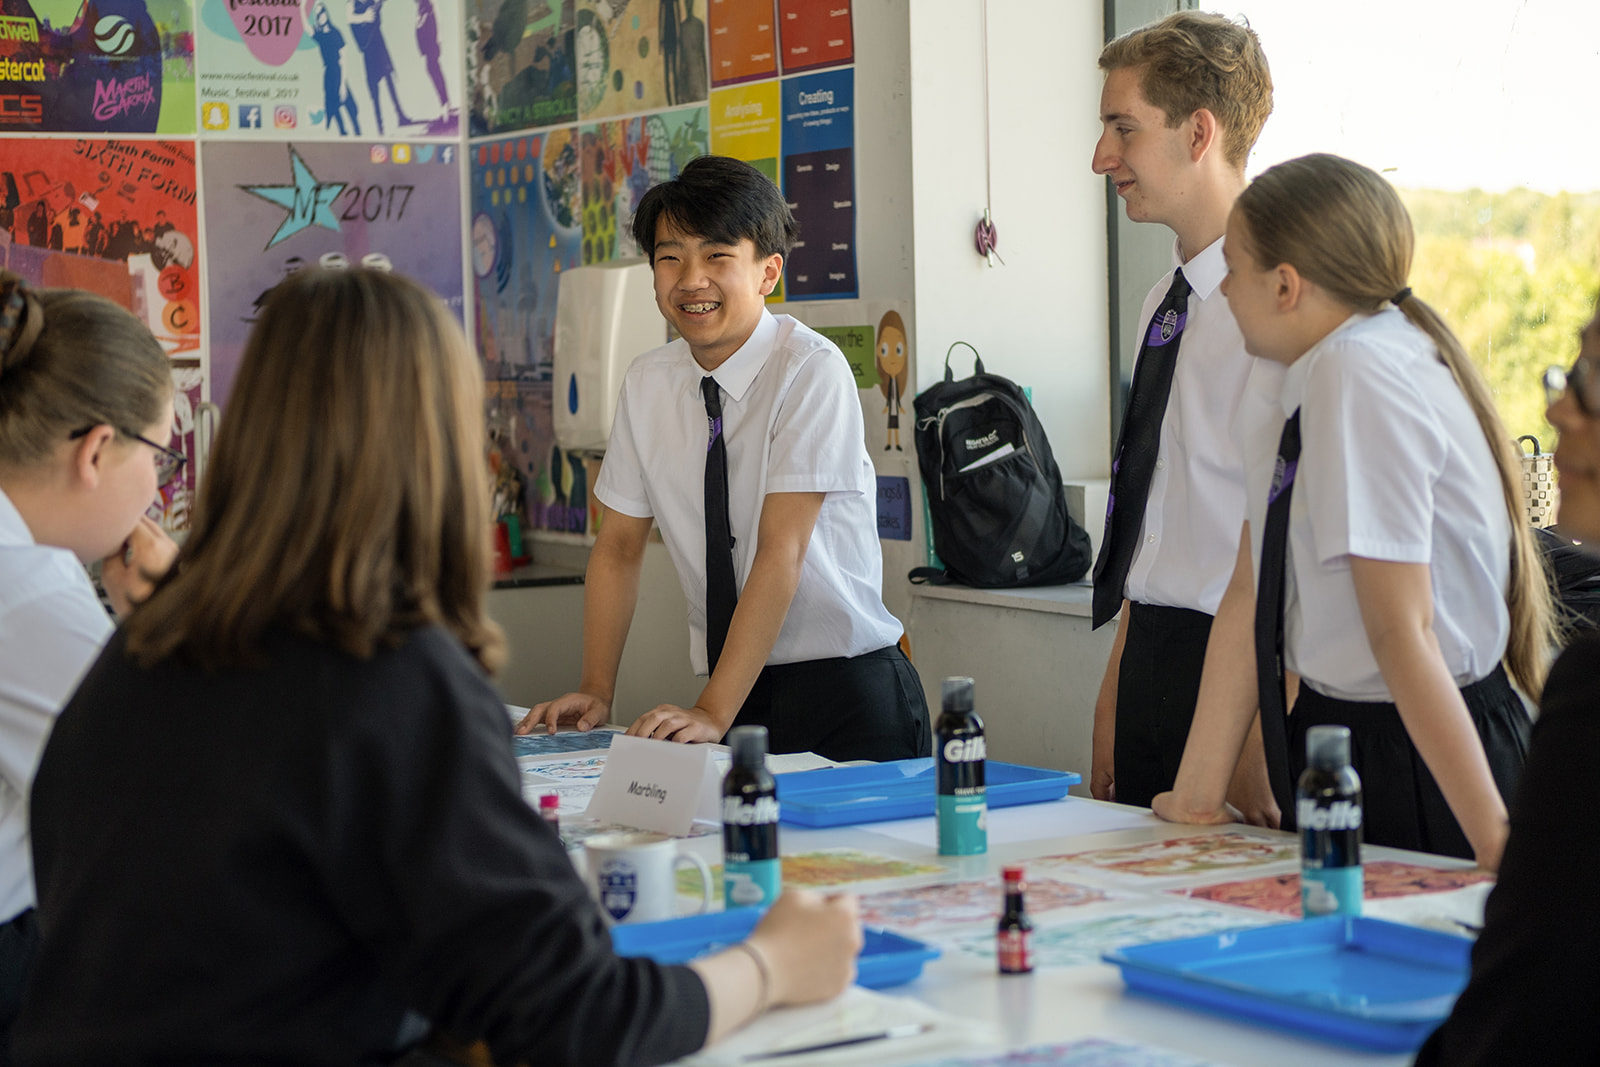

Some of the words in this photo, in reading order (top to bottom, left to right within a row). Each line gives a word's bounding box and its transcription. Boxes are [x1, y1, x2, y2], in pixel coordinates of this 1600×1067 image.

[244, 15, 292, 36] 2017
[799, 88, 834, 105] Creating
[141, 149, 175, 167] Form
[137, 168, 197, 206] FORM
[341, 184, 415, 222] 2017
[170, 305, 188, 329] C
[1011, 551, 1024, 562] 15
[627, 780, 667, 804] Marbling
